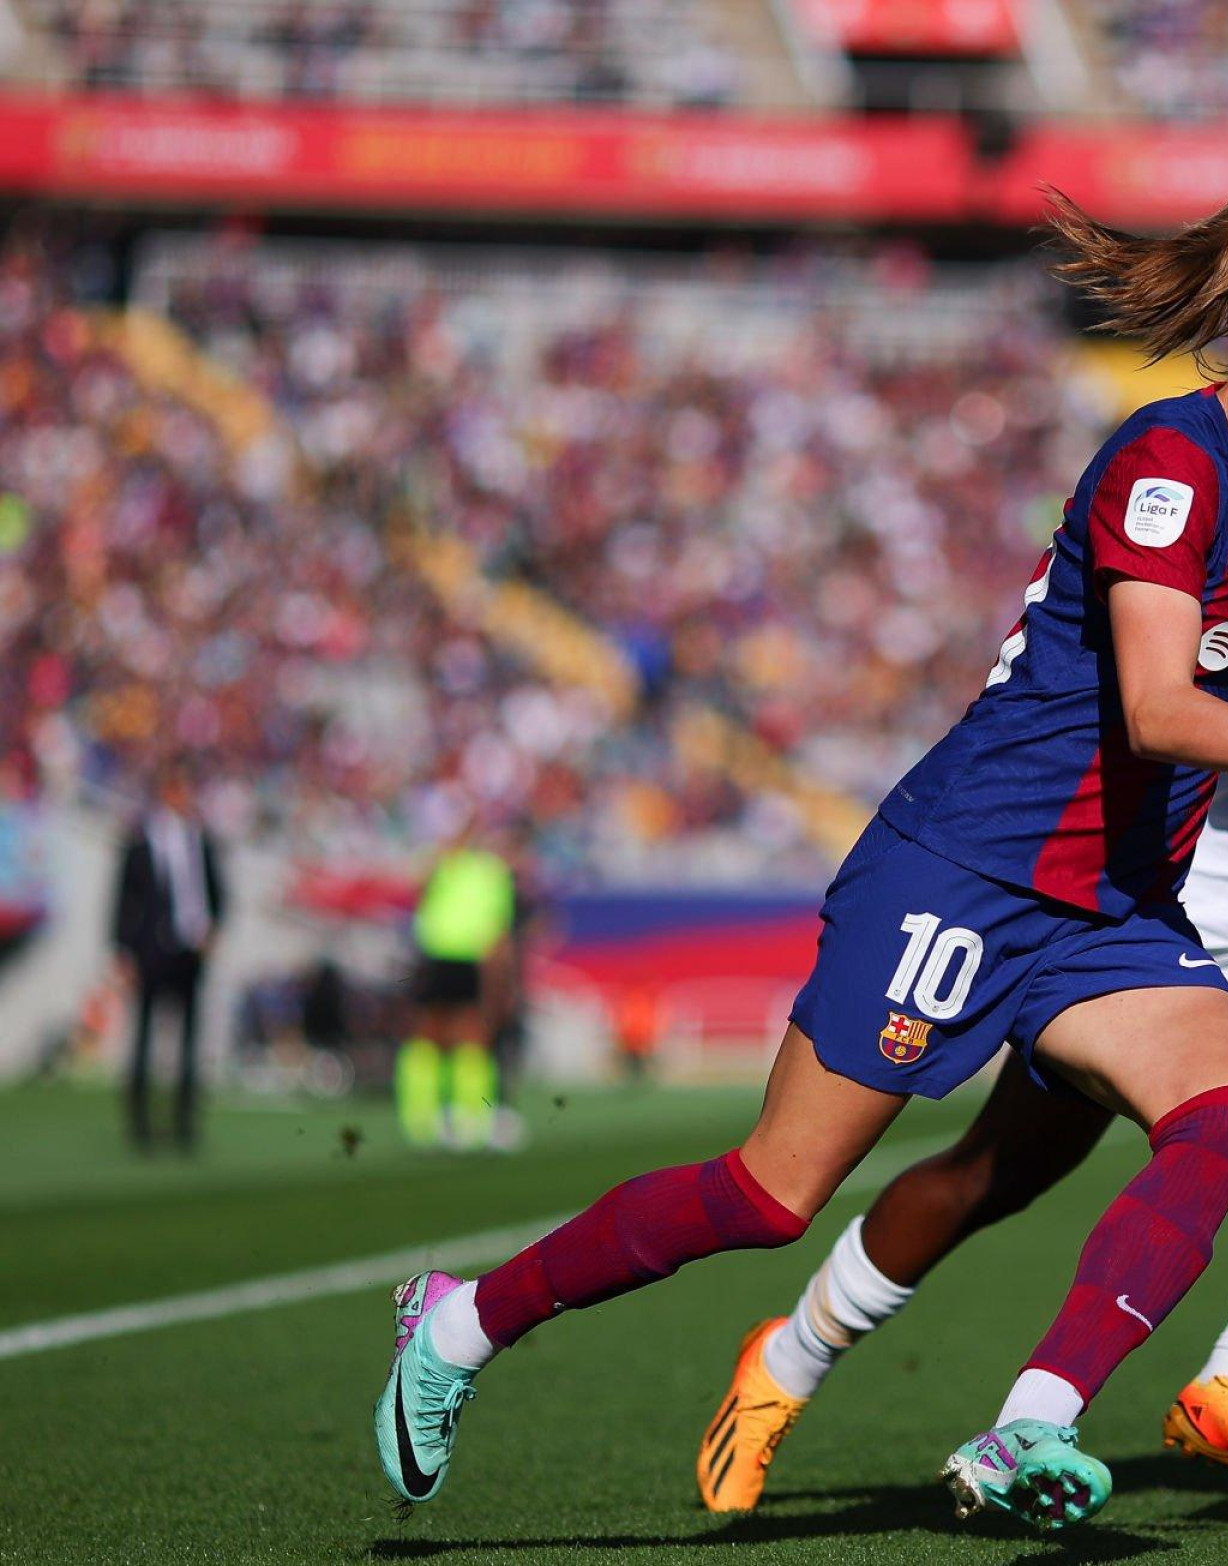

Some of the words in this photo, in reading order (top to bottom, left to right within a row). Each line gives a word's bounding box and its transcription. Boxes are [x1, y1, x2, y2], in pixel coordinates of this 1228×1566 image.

[1139, 502, 1167, 515] Liga
[1170, 508, 1179, 517] F
[884, 911, 984, 1020] 10
